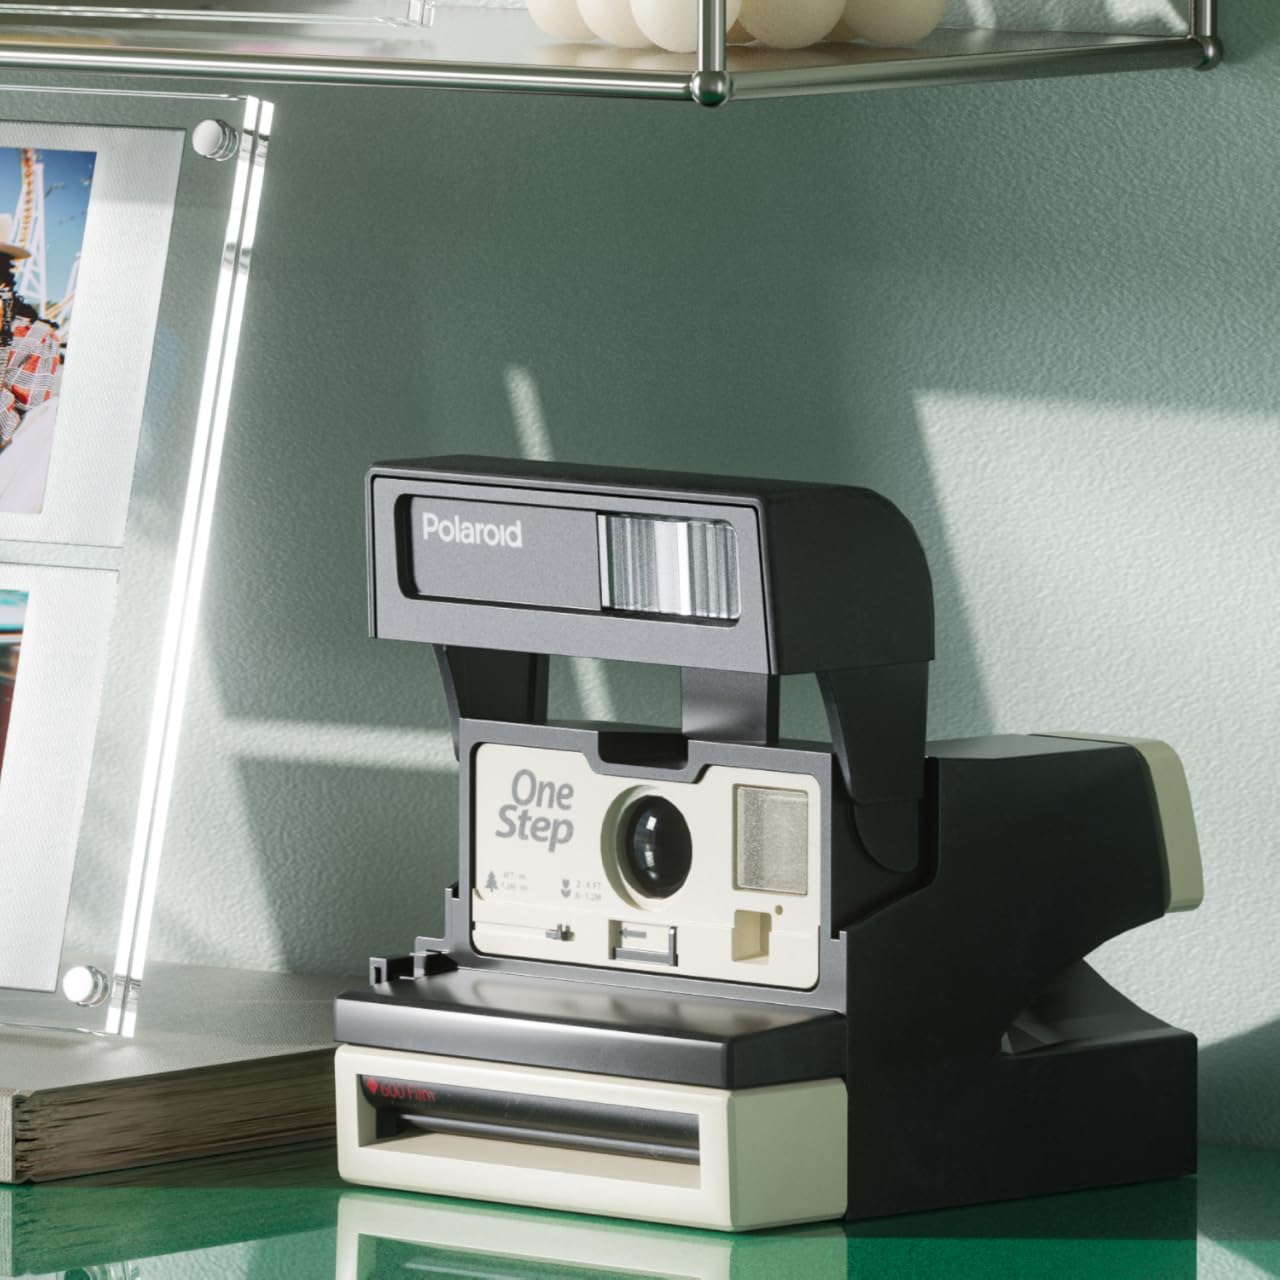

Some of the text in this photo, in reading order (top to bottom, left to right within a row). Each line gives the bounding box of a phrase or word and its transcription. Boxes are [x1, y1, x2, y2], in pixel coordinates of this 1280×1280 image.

[422, 511, 523, 548] Polaroid
[511, 768, 574, 811] One
[495, 804, 574, 853] Step
